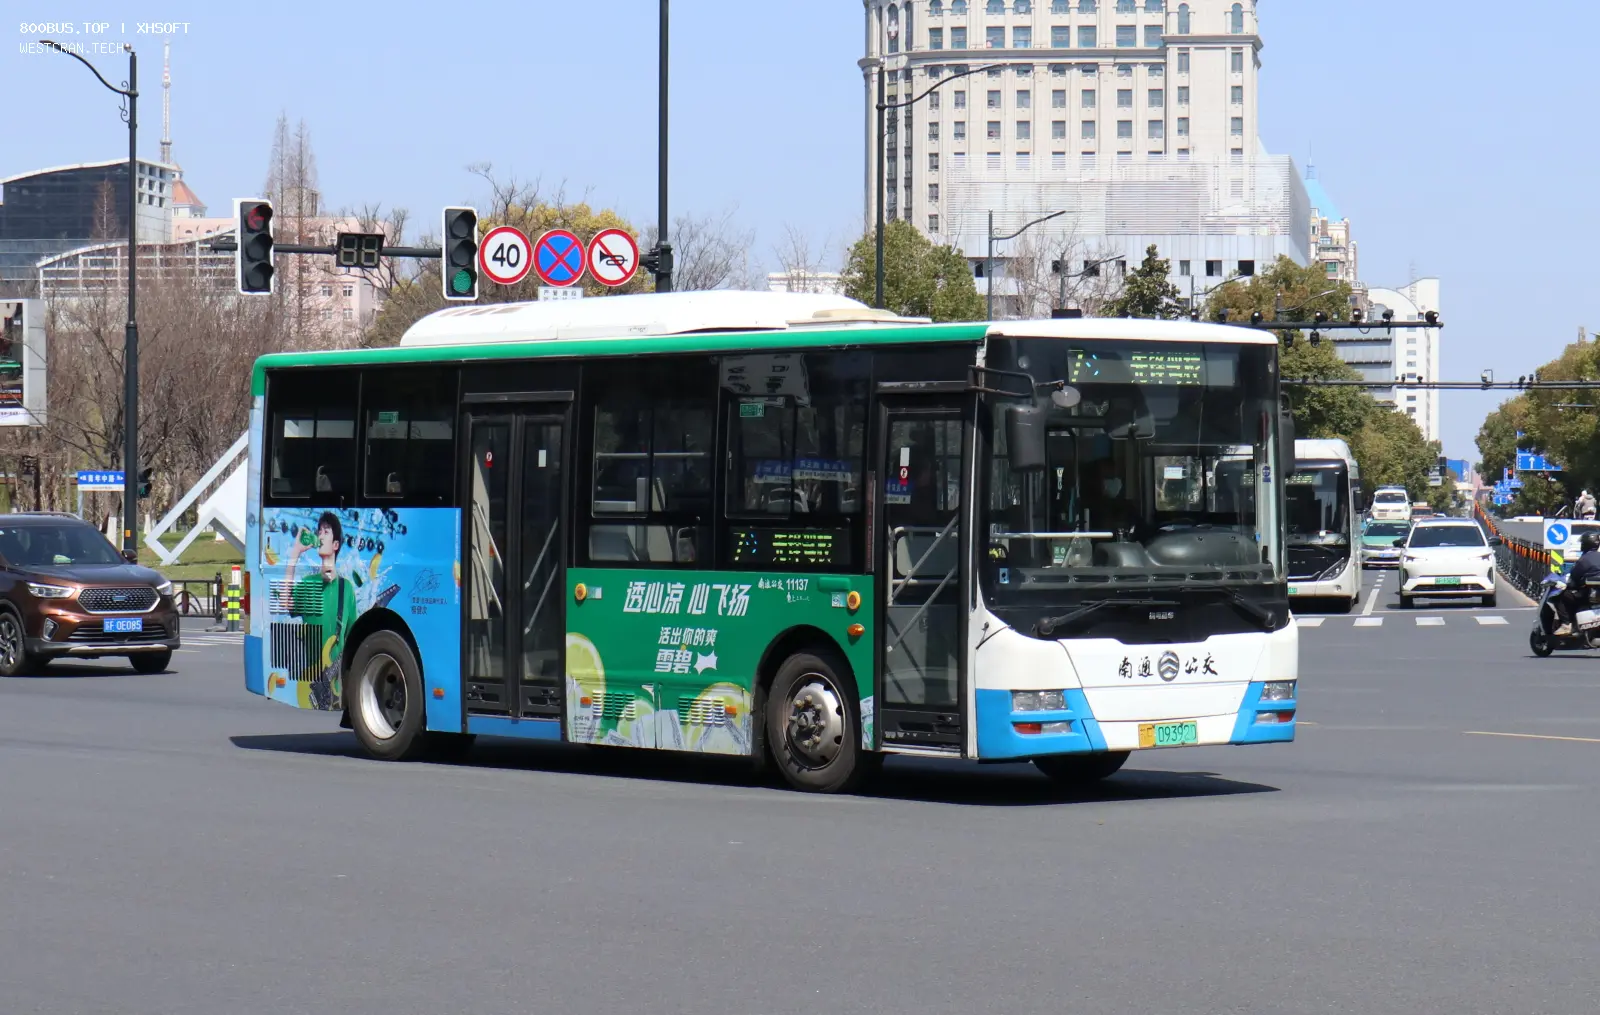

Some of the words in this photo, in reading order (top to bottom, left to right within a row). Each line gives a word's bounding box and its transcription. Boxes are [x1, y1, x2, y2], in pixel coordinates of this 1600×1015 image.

[491, 242, 520, 269] 40
[786, 578, 809, 591] 11137
[622, 581, 685, 614] 透心凉
[687, 583, 752, 616] 心飞扬
[657, 626, 718, 646] 活出你的爽
[654, 648, 693, 674] 雪碧
[1118, 655, 1154, 679] 南通
[1185, 652, 1218, 676] 公交
